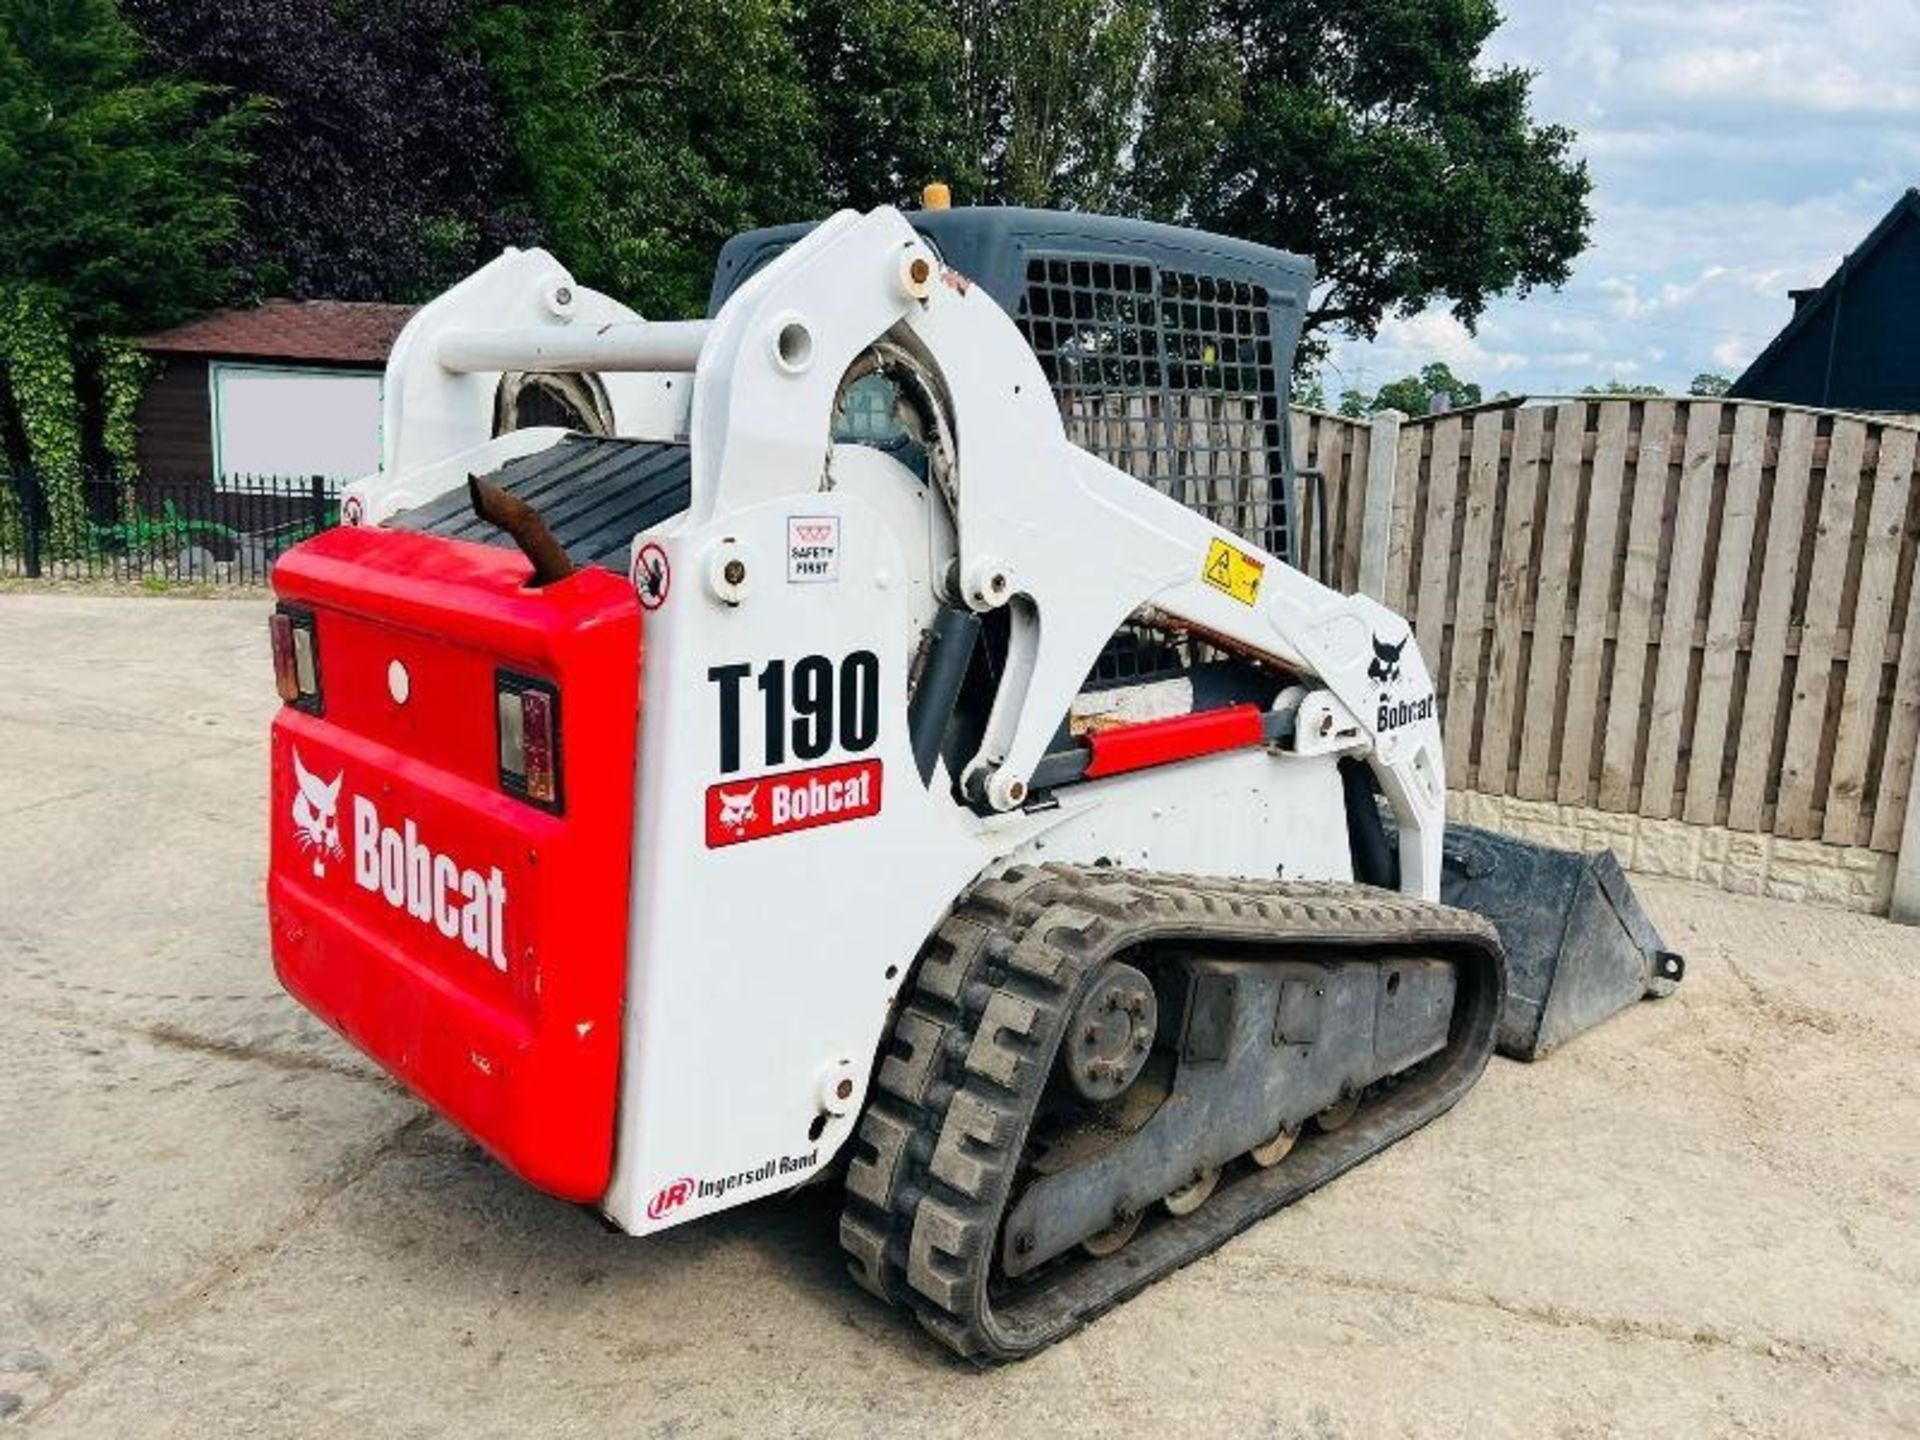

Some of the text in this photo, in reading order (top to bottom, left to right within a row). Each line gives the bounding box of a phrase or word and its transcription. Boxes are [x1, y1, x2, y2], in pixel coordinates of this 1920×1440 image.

[791, 546, 834, 560] SAFETY
[796, 561, 829, 574] FIRST
[707, 649, 880, 774] T190
[1377, 693, 1434, 733] Bobcat
[771, 770, 870, 825] Bobcat
[353, 795, 507, 973] Bobcat
[698, 1160, 776, 1199] Ingersoll
[779, 1149, 819, 1175] Rand
